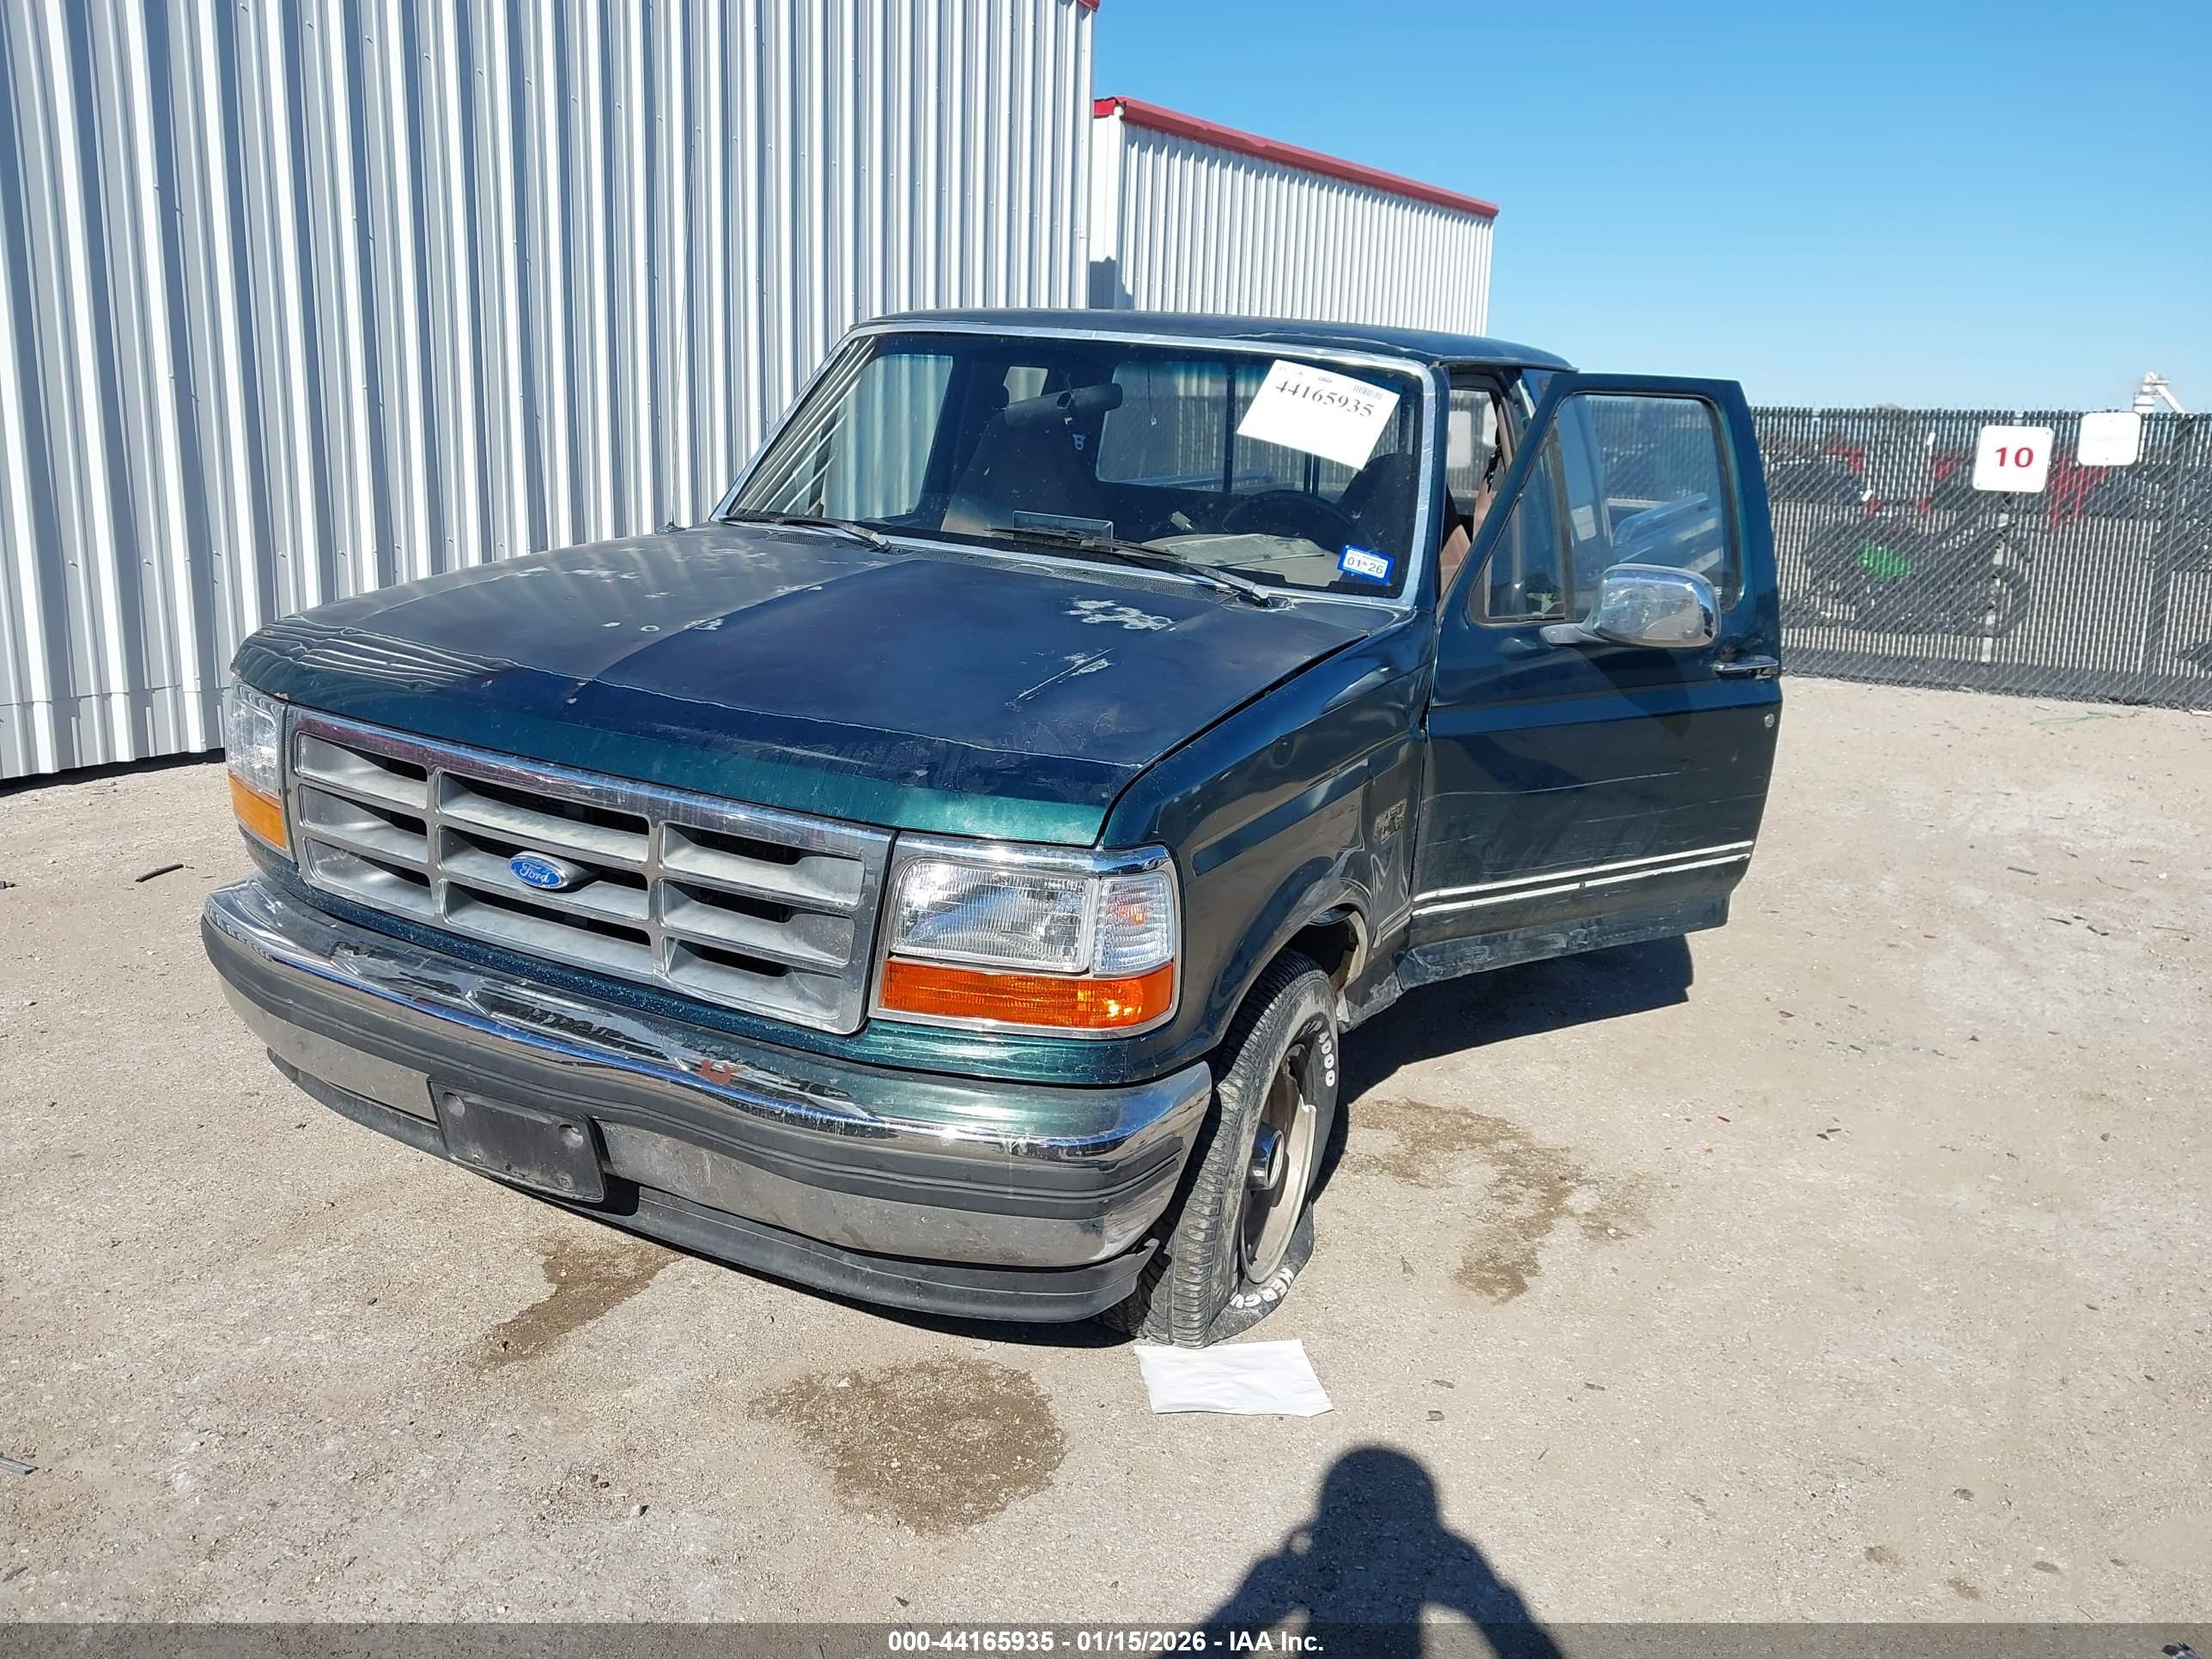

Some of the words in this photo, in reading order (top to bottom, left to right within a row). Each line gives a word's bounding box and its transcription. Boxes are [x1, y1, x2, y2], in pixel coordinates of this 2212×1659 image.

[1276, 380, 1374, 416] 44165935
[1995, 446, 2034, 468] 10
[520, 862, 550, 884] Ford
[1230, 1265, 1295, 1310] HERCU
